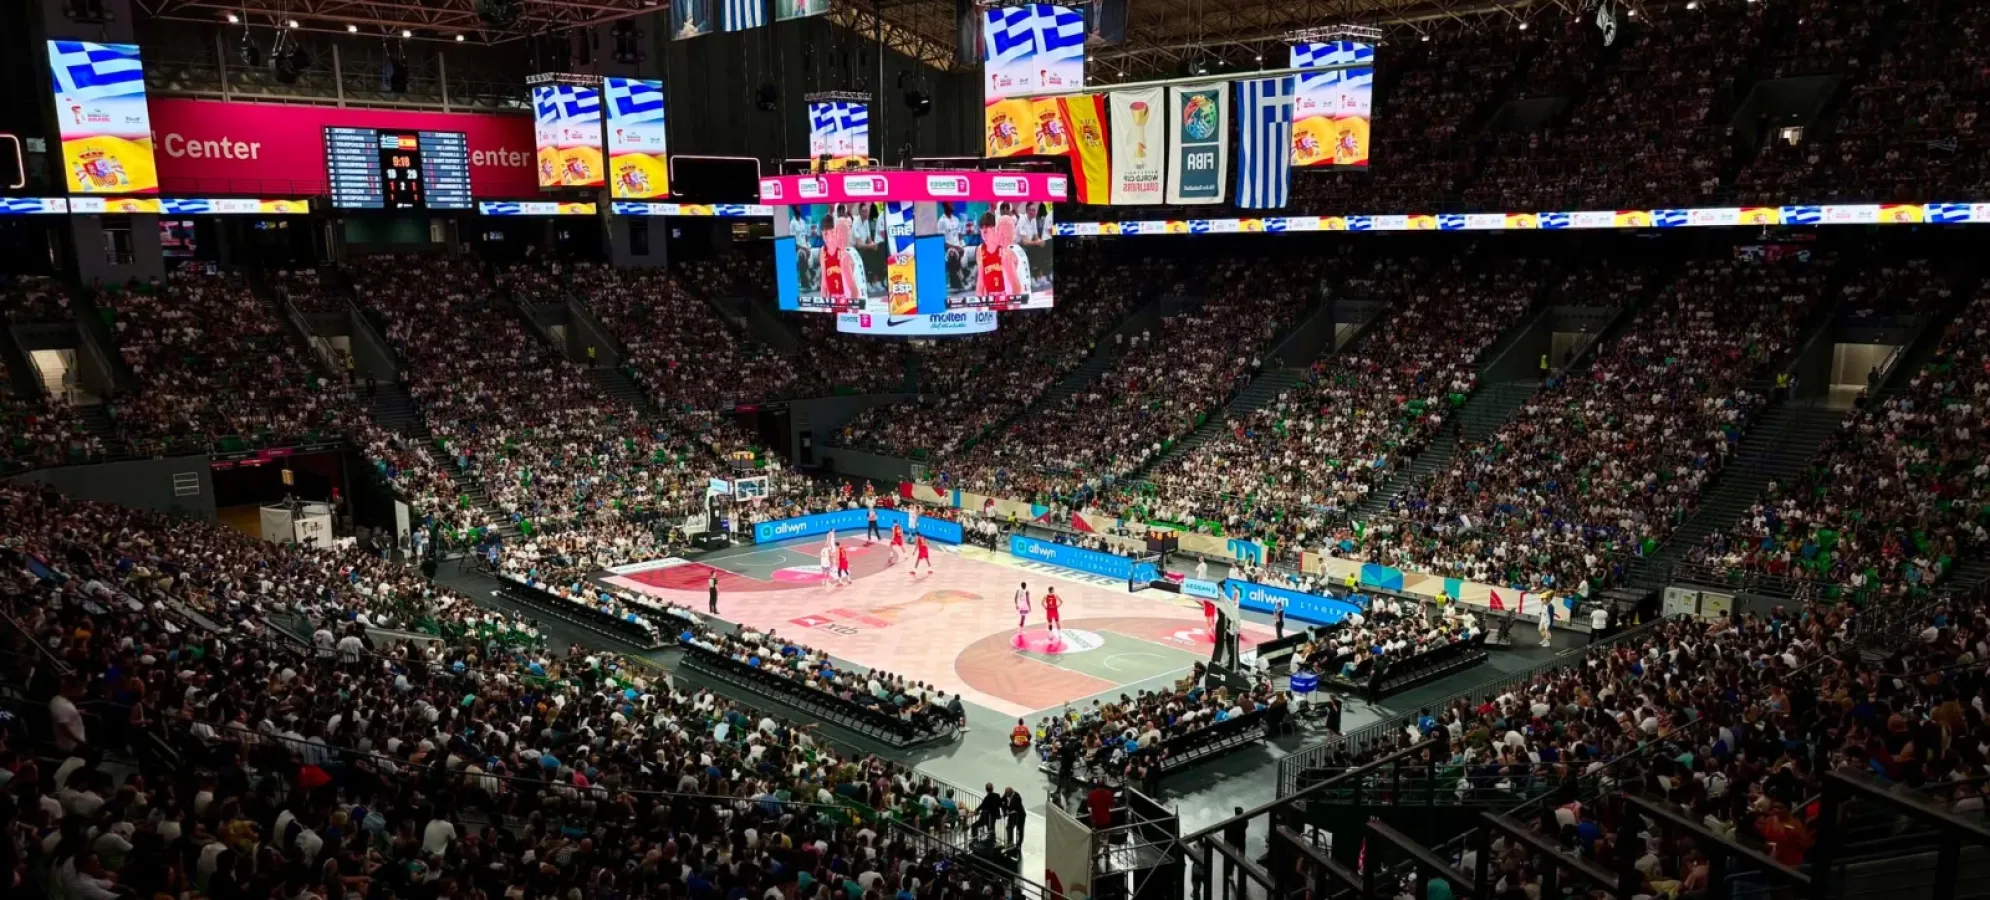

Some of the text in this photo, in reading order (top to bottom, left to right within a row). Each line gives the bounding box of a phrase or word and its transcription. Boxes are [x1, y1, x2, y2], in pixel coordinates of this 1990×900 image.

[164, 133, 261, 160] Center
[468, 146, 531, 167] enter
[889, 226, 912, 236] GRE
[893, 283, 913, 293] ESP
[930, 312, 967, 322] molten
[775, 522, 807, 534] allwyn
[1028, 543, 1057, 560] allwyn
[821, 623, 859, 635] xtb
